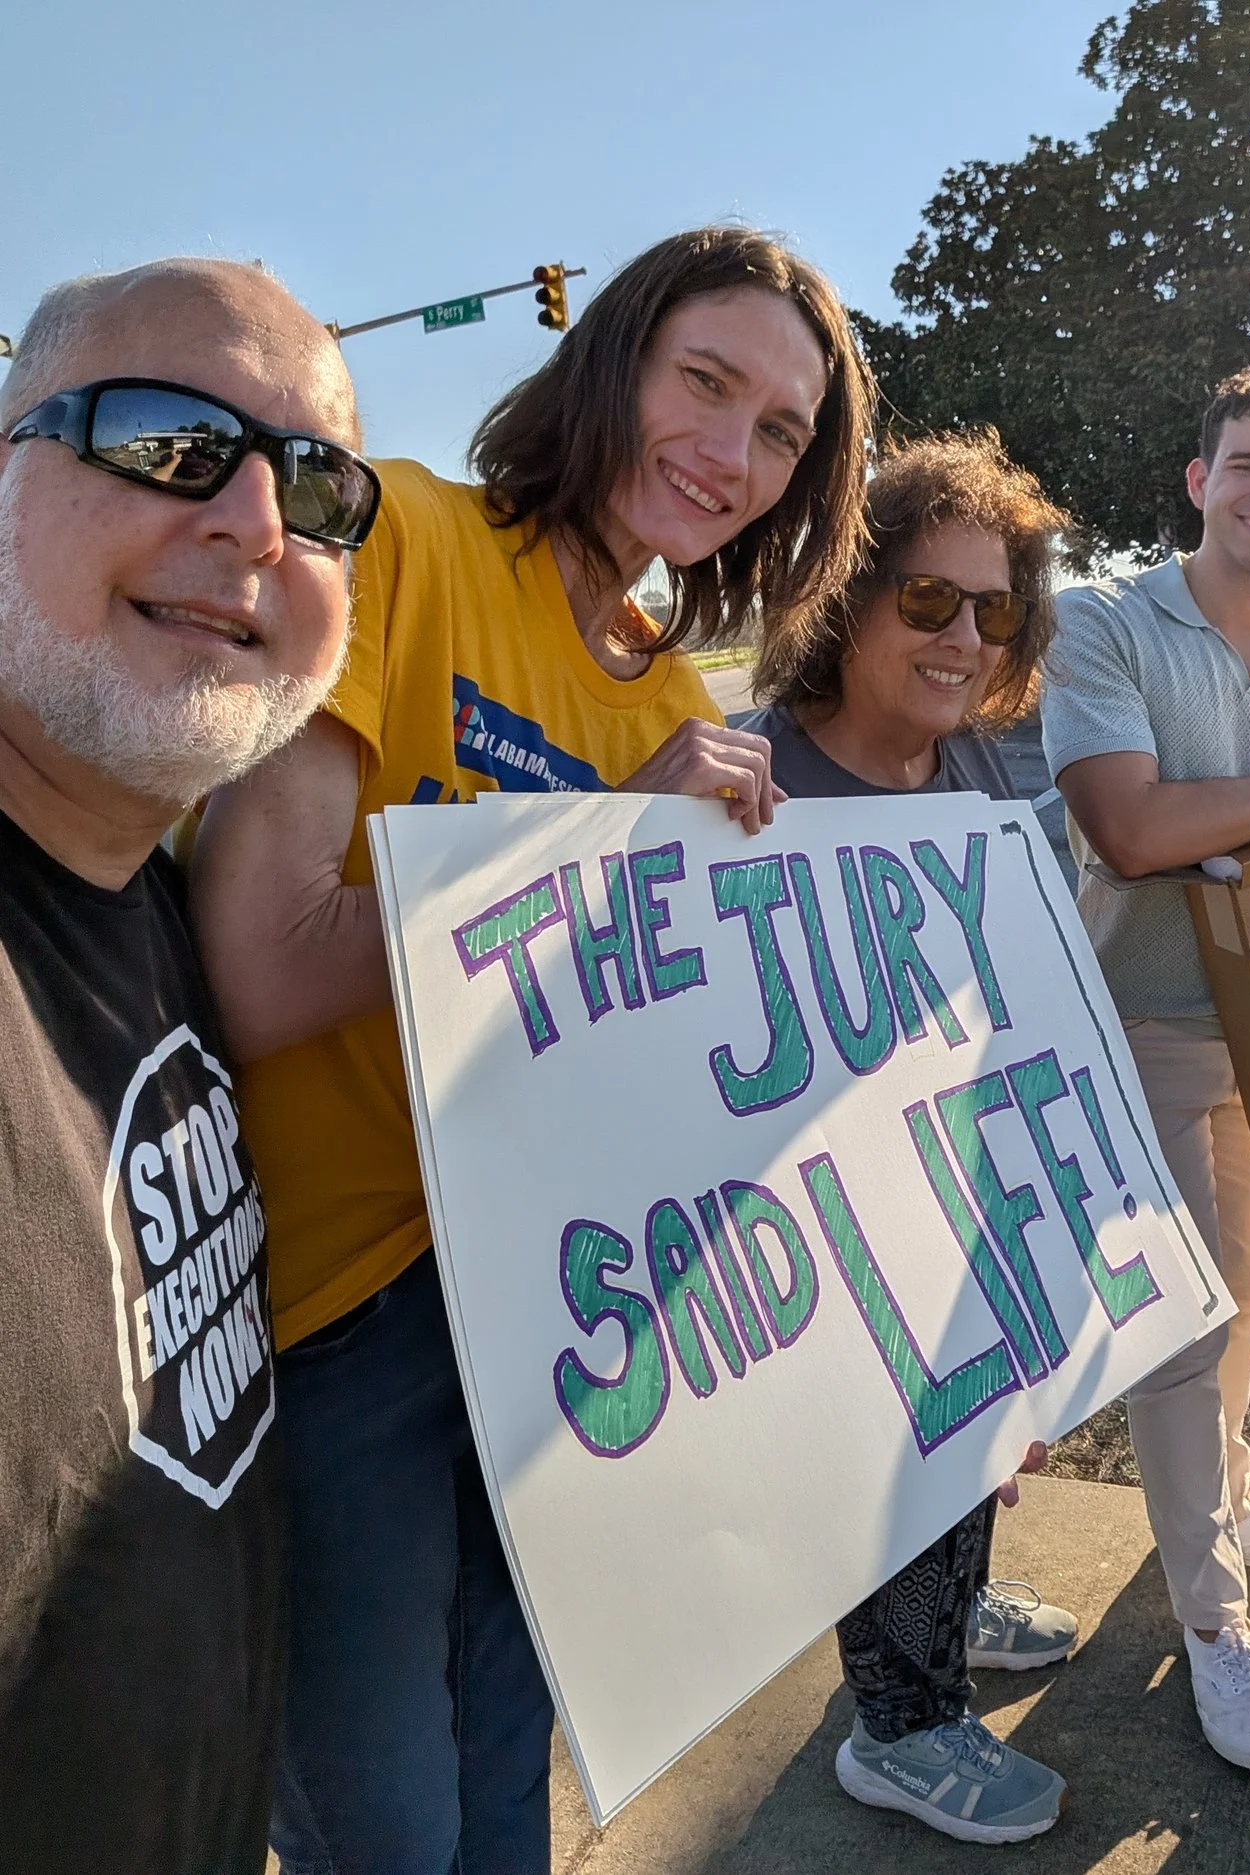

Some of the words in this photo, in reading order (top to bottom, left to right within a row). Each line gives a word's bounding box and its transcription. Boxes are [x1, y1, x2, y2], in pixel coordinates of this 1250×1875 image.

[436, 305, 464, 322] Perry
[452, 841, 707, 1059] THE
[708, 831, 1012, 1117] JURY
[129, 1086, 244, 1266] STOP
[552, 1179, 819, 1459] SAID
[798, 1047, 1164, 1461] LIFE!
[179, 1273, 269, 1457] NOW!
[890, 1764, 931, 1792] Columbia
